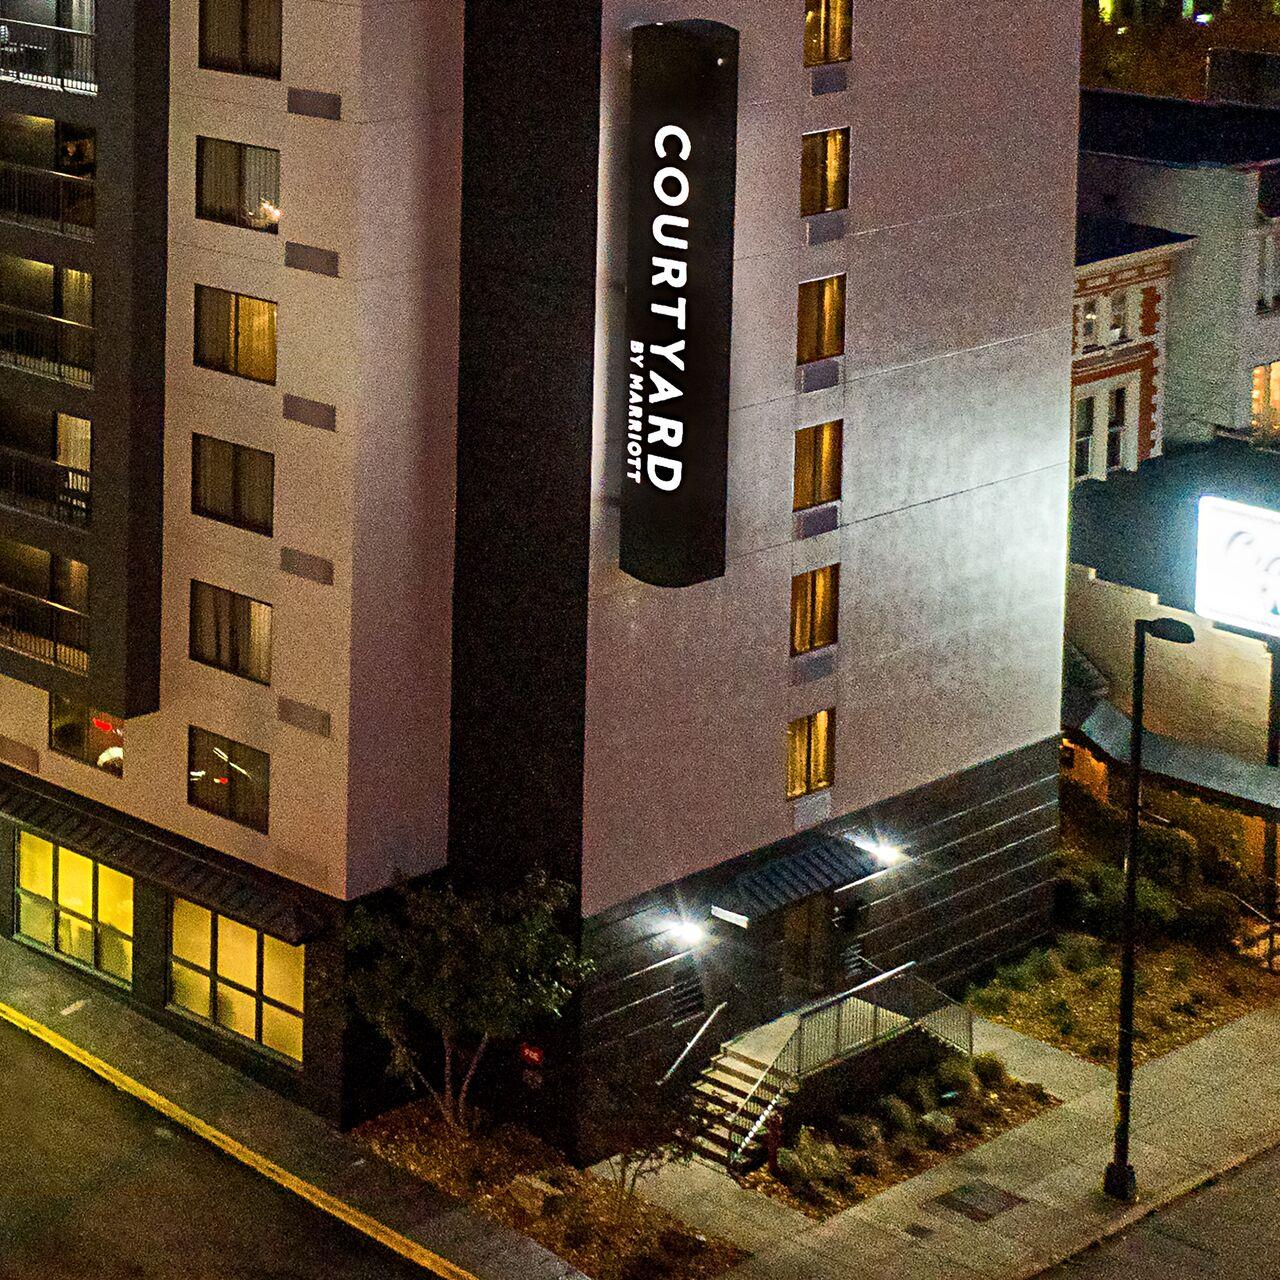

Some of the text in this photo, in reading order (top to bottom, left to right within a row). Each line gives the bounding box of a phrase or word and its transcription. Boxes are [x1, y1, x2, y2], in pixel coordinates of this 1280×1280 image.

[626, 340, 646, 484] BY MARRIOTT
[646, 124, 692, 492] COURTYARD
